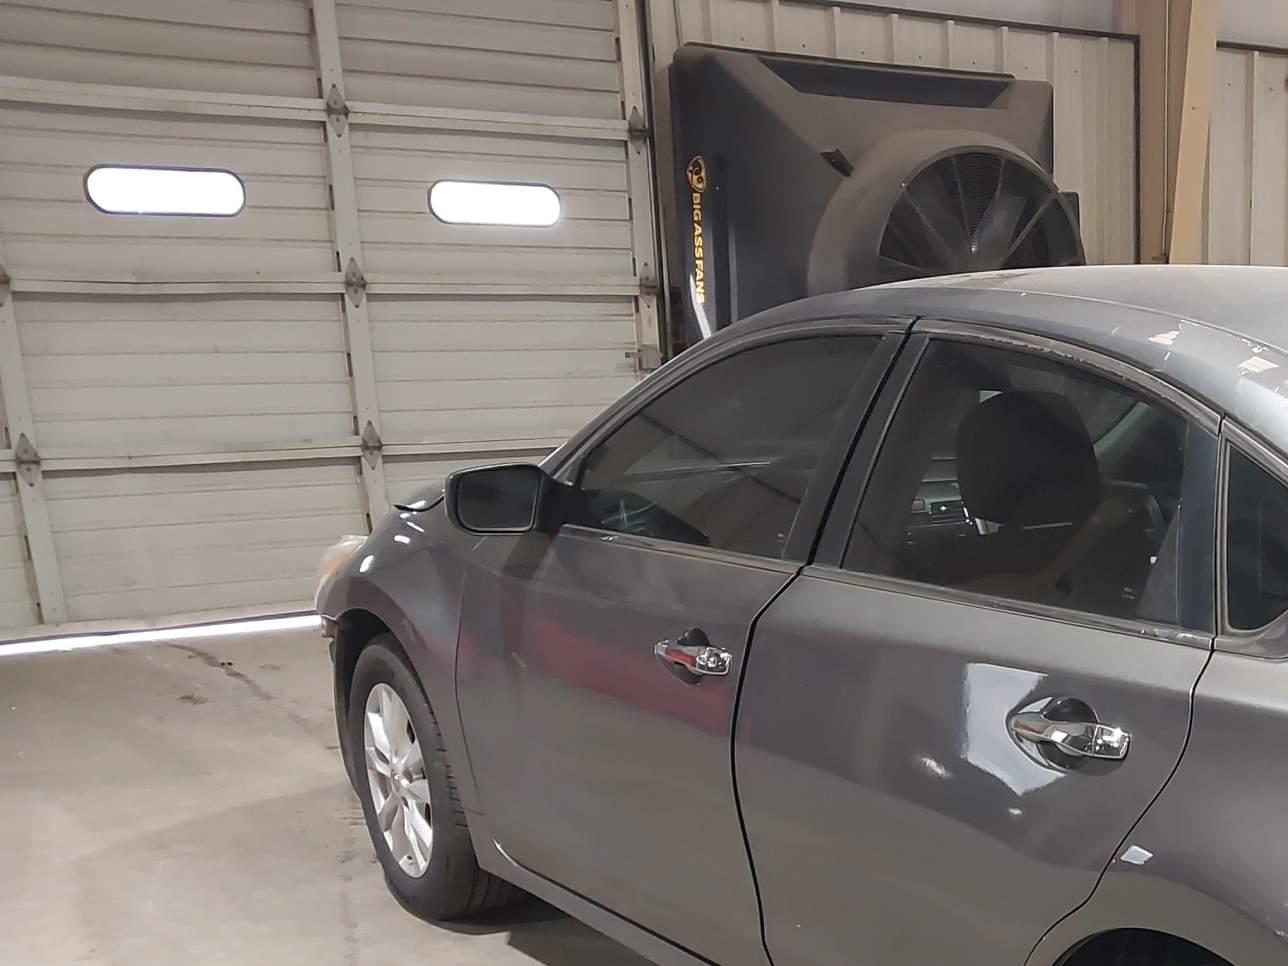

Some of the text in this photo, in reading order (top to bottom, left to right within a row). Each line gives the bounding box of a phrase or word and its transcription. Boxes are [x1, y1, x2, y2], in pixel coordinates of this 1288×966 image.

[692, 192, 705, 304] BIG ASS FANS
